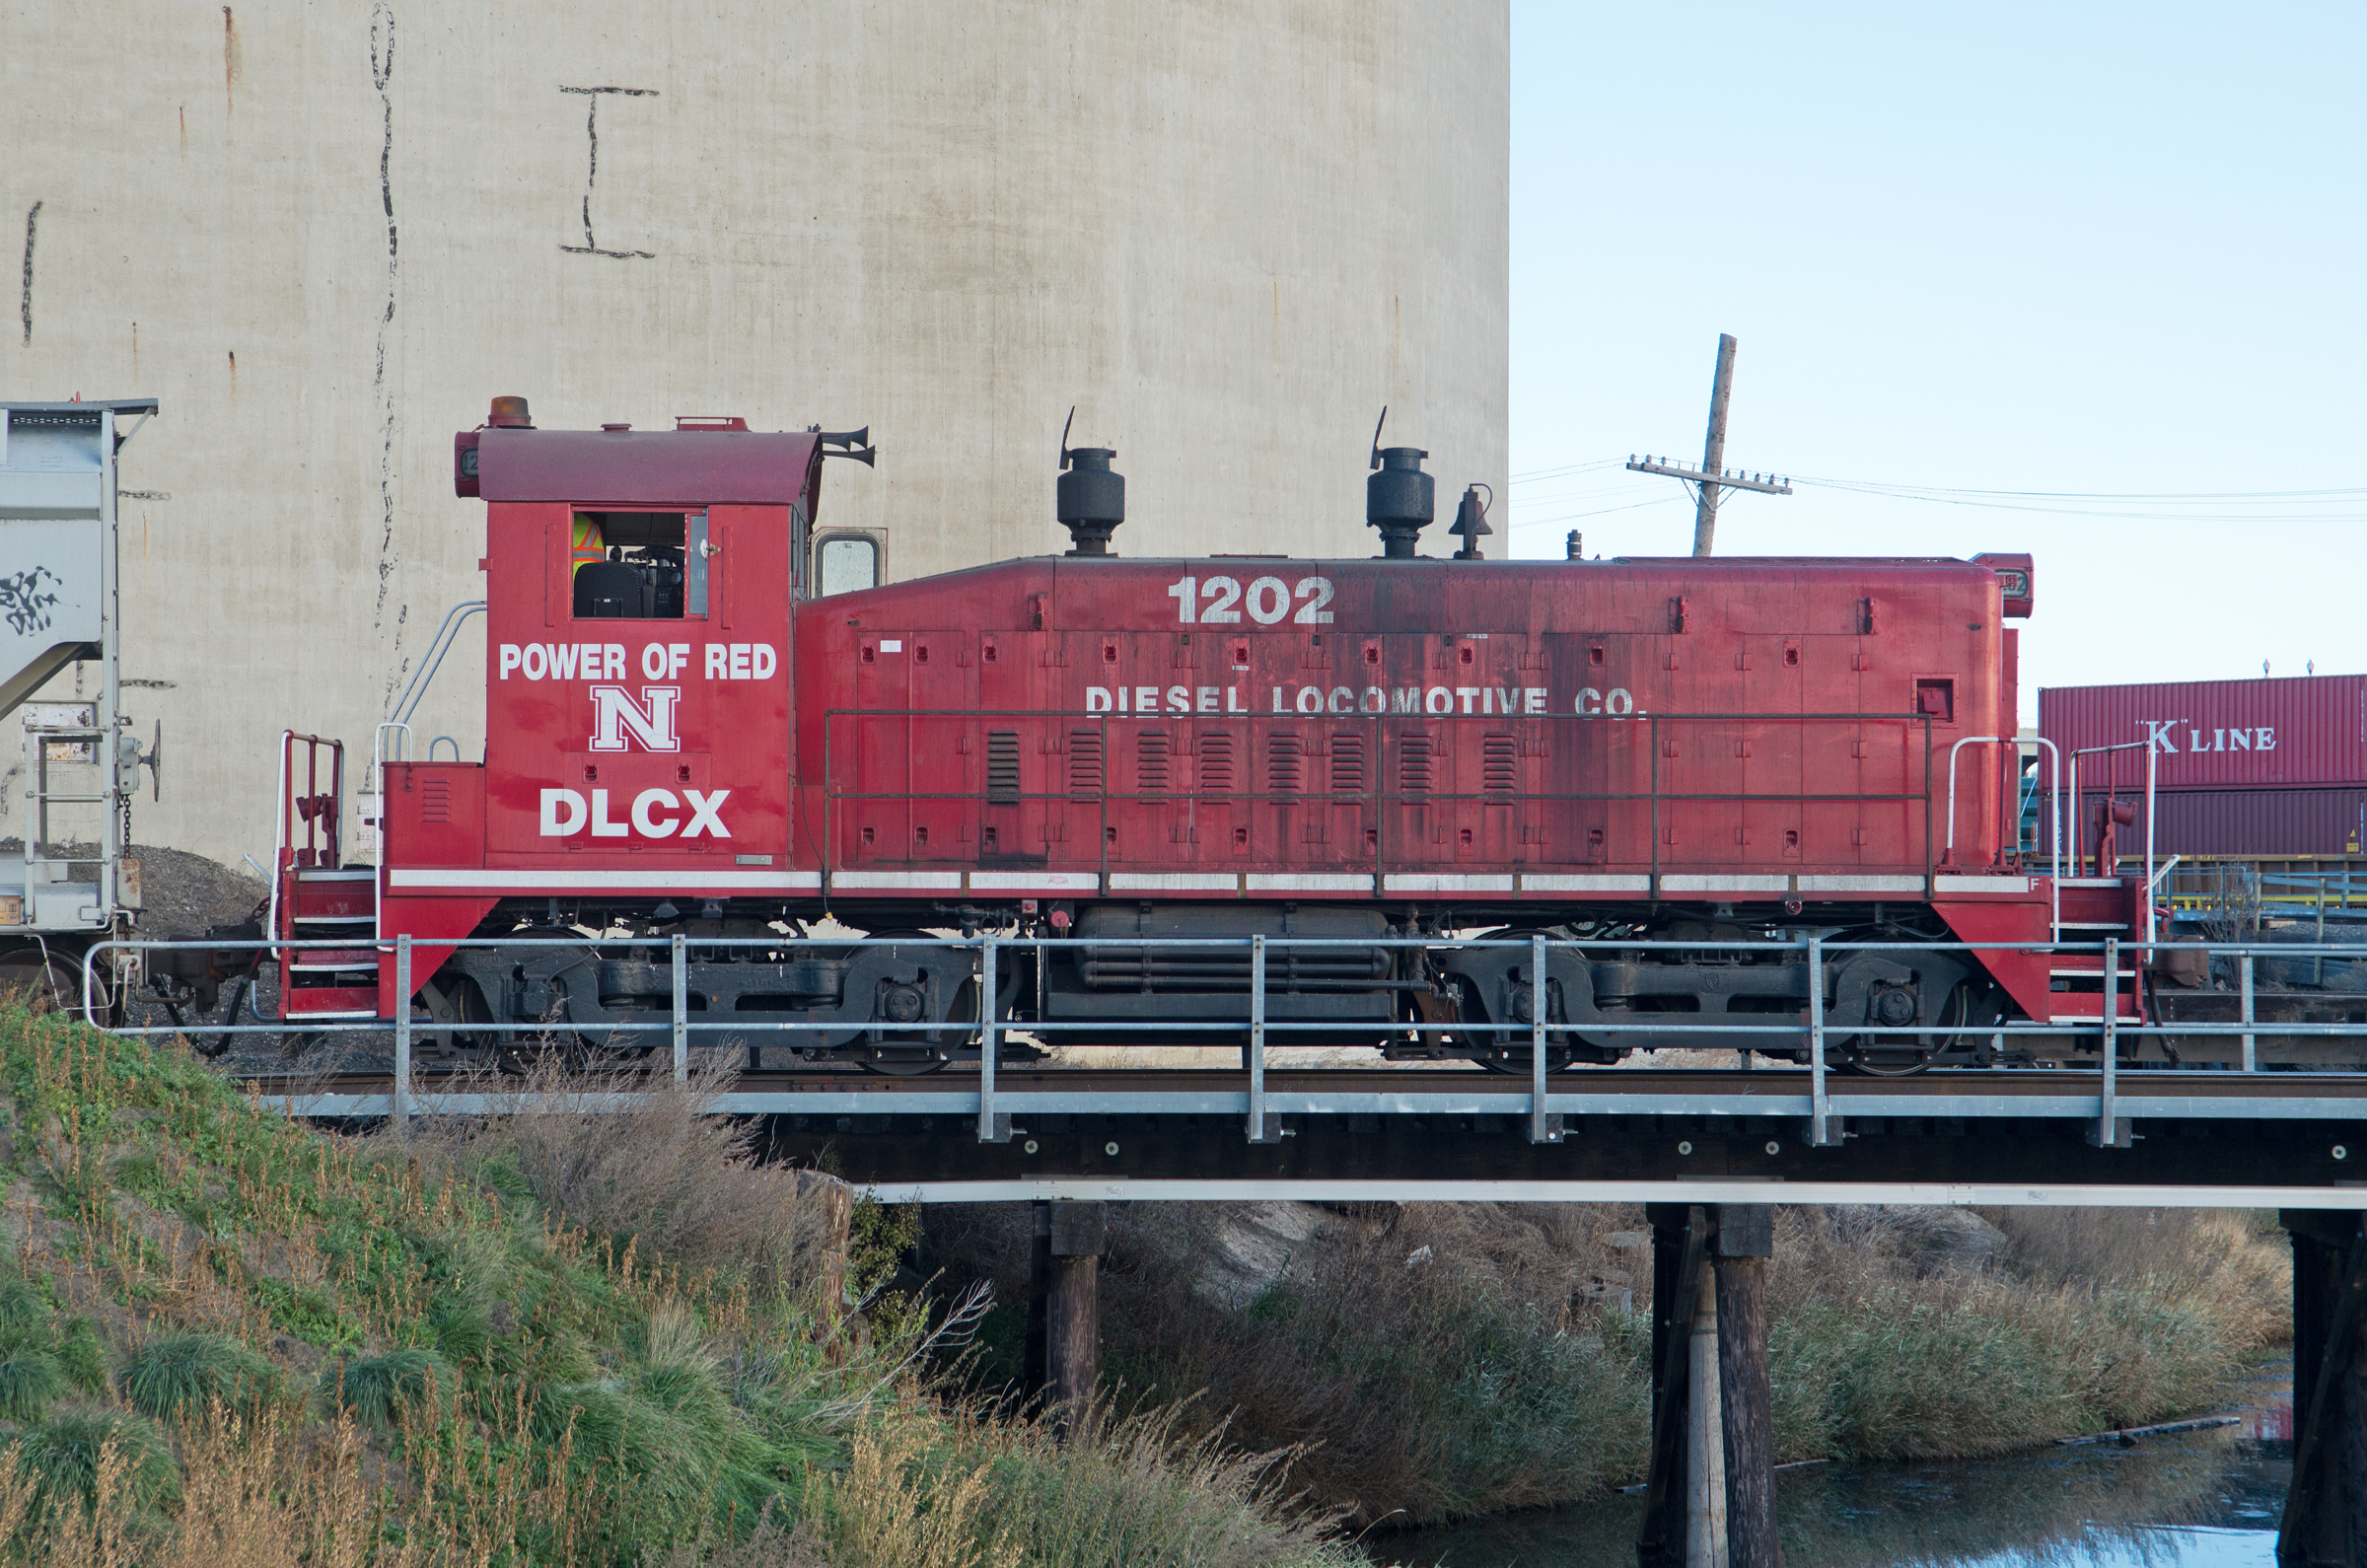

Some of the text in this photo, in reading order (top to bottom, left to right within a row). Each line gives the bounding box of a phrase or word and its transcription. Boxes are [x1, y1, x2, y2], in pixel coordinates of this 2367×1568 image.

[1168, 575, 1335, 625] 1202
[499, 642, 777, 681] POWER OF RED
[589, 684, 681, 752] N
[1086, 685, 1647, 721] DIESEL LOCOMOTIVE CO.
[2190, 727, 2277, 752] LINE
[539, 788, 733, 838] DLCX
[2030, 878, 2041, 891] F
